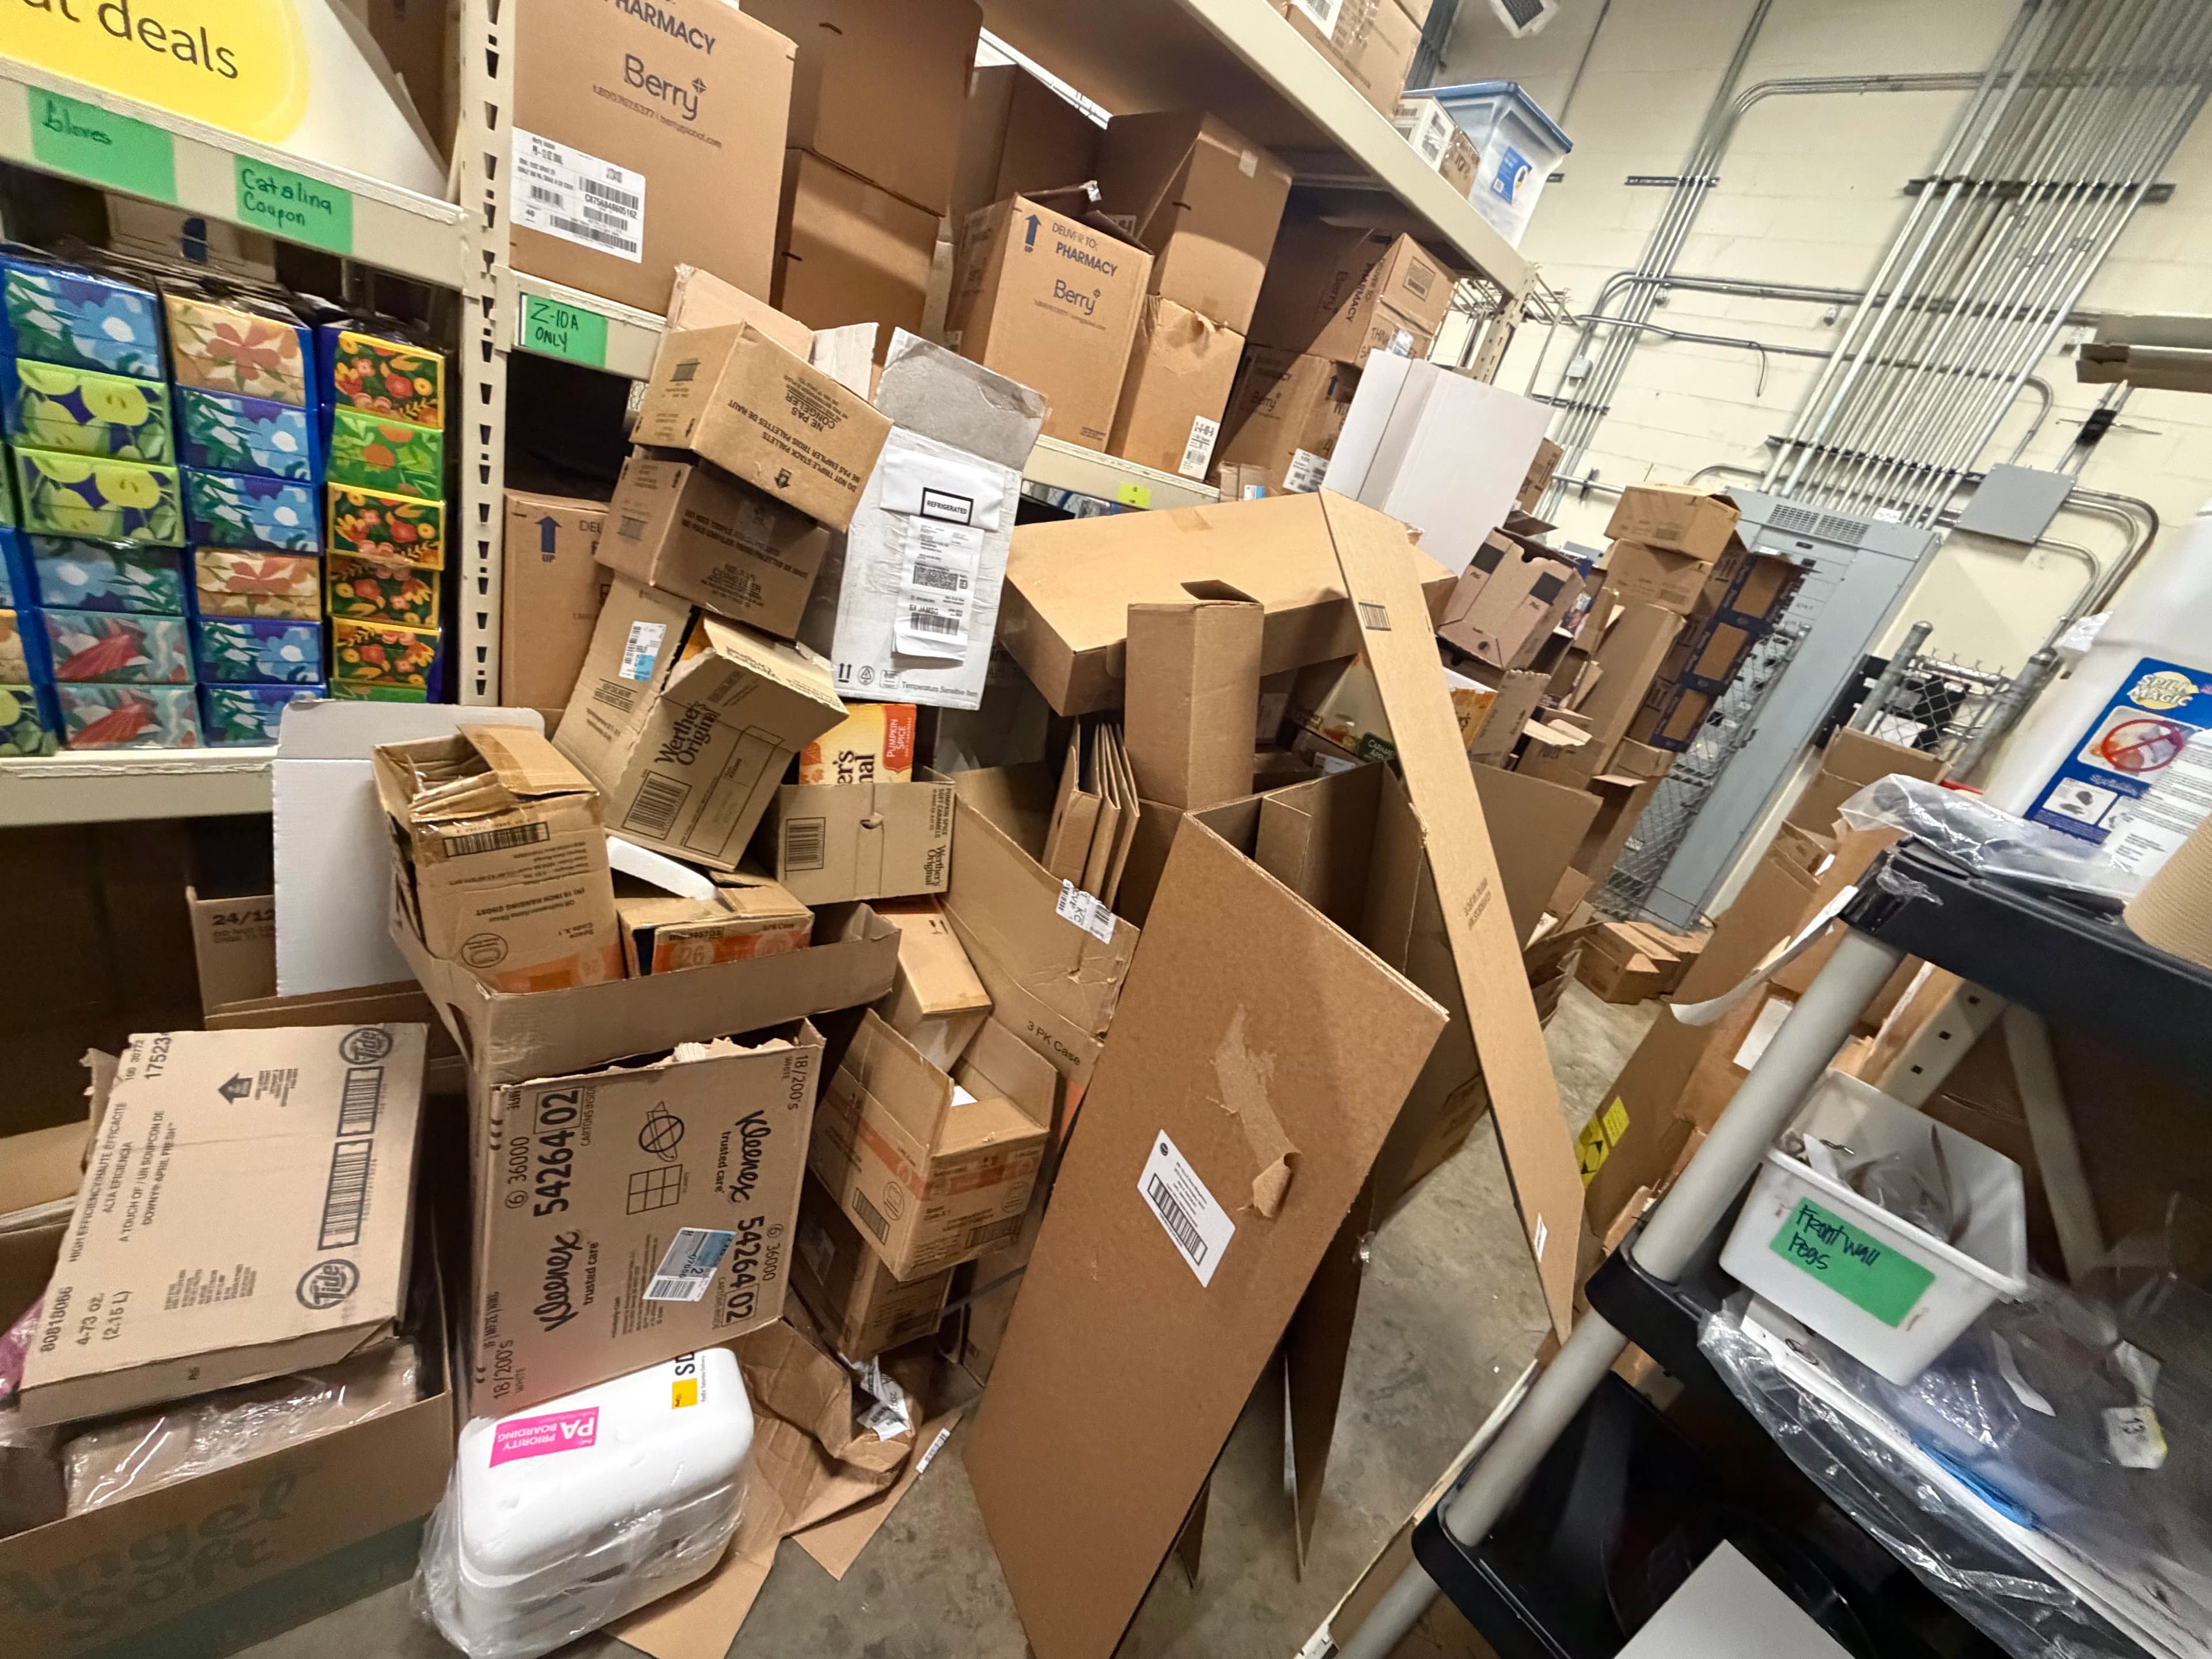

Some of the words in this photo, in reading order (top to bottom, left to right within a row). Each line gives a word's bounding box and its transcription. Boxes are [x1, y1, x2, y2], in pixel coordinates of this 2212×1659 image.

[97, 0, 238, 79] deals
[612, 0, 716, 55] HARMACY
[624, 53, 698, 121] Berry
[244, 192, 306, 229] Coupon
[1052, 222, 1085, 244] DELIVER
[1056, 241, 1118, 276] PHARMACY
[1053, 278, 1096, 316] Berry
[1345, 263, 1376, 323] PHARMACY
[535, 327, 567, 353] ONLY
[728, 399, 748, 415] HAUT
[747, 410, 759, 421] DE
[785, 392, 837, 429] CONGELER
[790, 406, 810, 423] PAS
[757, 417, 793, 441] PALETTES
[809, 418, 825, 432] NE
[760, 431, 791, 453] PALLETS
[790, 437, 812, 453] TROIS
[790, 448, 813, 465] STACK
[810, 449, 839, 470] EMPILER
[810, 460, 834, 479] TRIPLE
[838, 465, 852, 478] PAS
[834, 474, 848, 486] NOT
[846, 482, 857, 492] DO
[850, 472, 861, 483] NE
[926, 500, 968, 514] REFRIGERATED
[902, 681, 939, 692] Temperature
[940, 685, 965, 695] Sensitive
[2126, 685, 2194, 707] MAGIC
[653, 698, 707, 764] Werther's
[675, 706, 721, 768] Original
[887, 718, 899, 759] PUMPKIN
[897, 725, 907, 750] SPICE
[943, 788, 952, 817] PUMPKIN
[934, 804, 944, 838] CARAMELS
[941, 818, 950, 835] SPICE
[923, 849, 936, 885] Original
[932, 845, 946, 886] Werther's
[144, 1032, 172, 1080] 17523
[1027, 1020, 1035, 1032] 3
[1036, 1026, 1052, 1046] PK
[1053, 1040, 1081, 1066] Case
[787, 1054, 809, 1110] 18/200's
[154, 1109, 165, 1123] DE
[540, 1090, 578, 1126] 02
[581, 1112, 593, 1146] CARTONS
[507, 1137, 530, 1184] 36000
[719, 1131, 732, 1171] trusted
[730, 1109, 771, 1205] Kleenex
[137, 1169, 147, 1180] UN
[155, 1155, 170, 1184] APRIL
[533, 1130, 575, 1217] 54264
[714, 1169, 727, 1192] care
[103, 1189, 118, 1213] ALTA
[131, 1186, 141, 1199] OF
[122, 1198, 139, 1235] TOUCH
[69, 1232, 85, 1263] HIGH
[120, 1234, 129, 1243] A
[730, 1215, 765, 1288] 54264
[1789, 1232, 1830, 1270] Pegs
[588, 1241, 600, 1266] care
[763, 1243, 781, 1281] 36000
[533, 1231, 582, 1332] Kleenex
[583, 1267, 597, 1306] trusted
[111, 1290, 134, 1305] L)
[726, 1291, 755, 1323] 02
[494, 1339, 514, 1400] 18/200's
[497, 1423, 557, 1442] BOARDING
[502, 1433, 555, 1451] PRIORITY
[559, 1416, 594, 1440] PA
